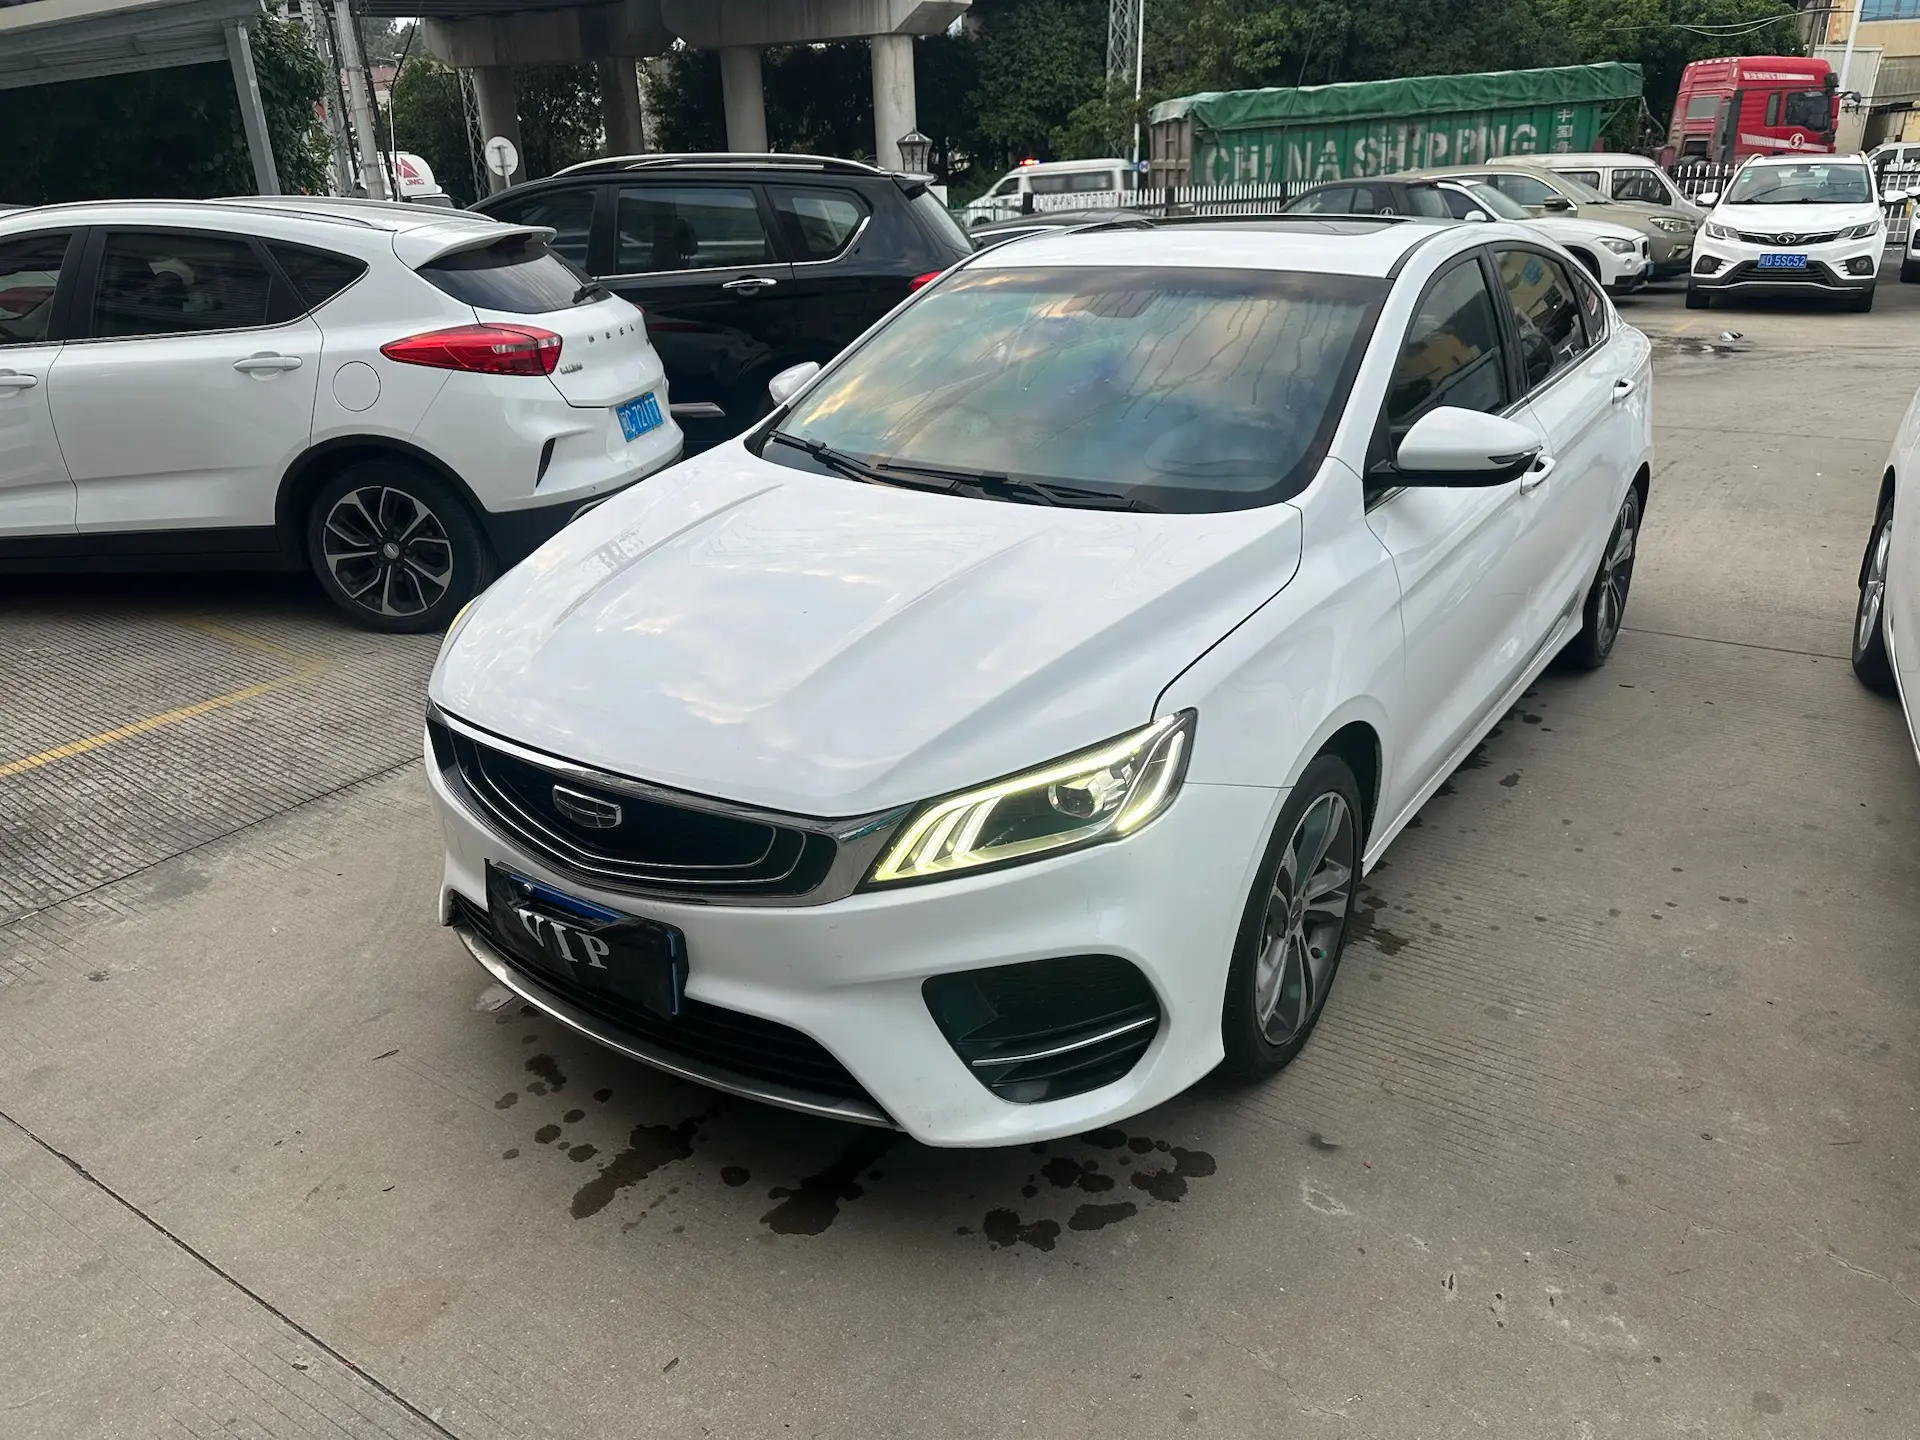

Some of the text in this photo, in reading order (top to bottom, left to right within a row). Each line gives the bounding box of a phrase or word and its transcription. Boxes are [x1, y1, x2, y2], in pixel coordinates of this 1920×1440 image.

[405, 178, 425, 186] JMC
[1206, 140, 1342, 186] CHINA
[518, 908, 610, 970] VIP
